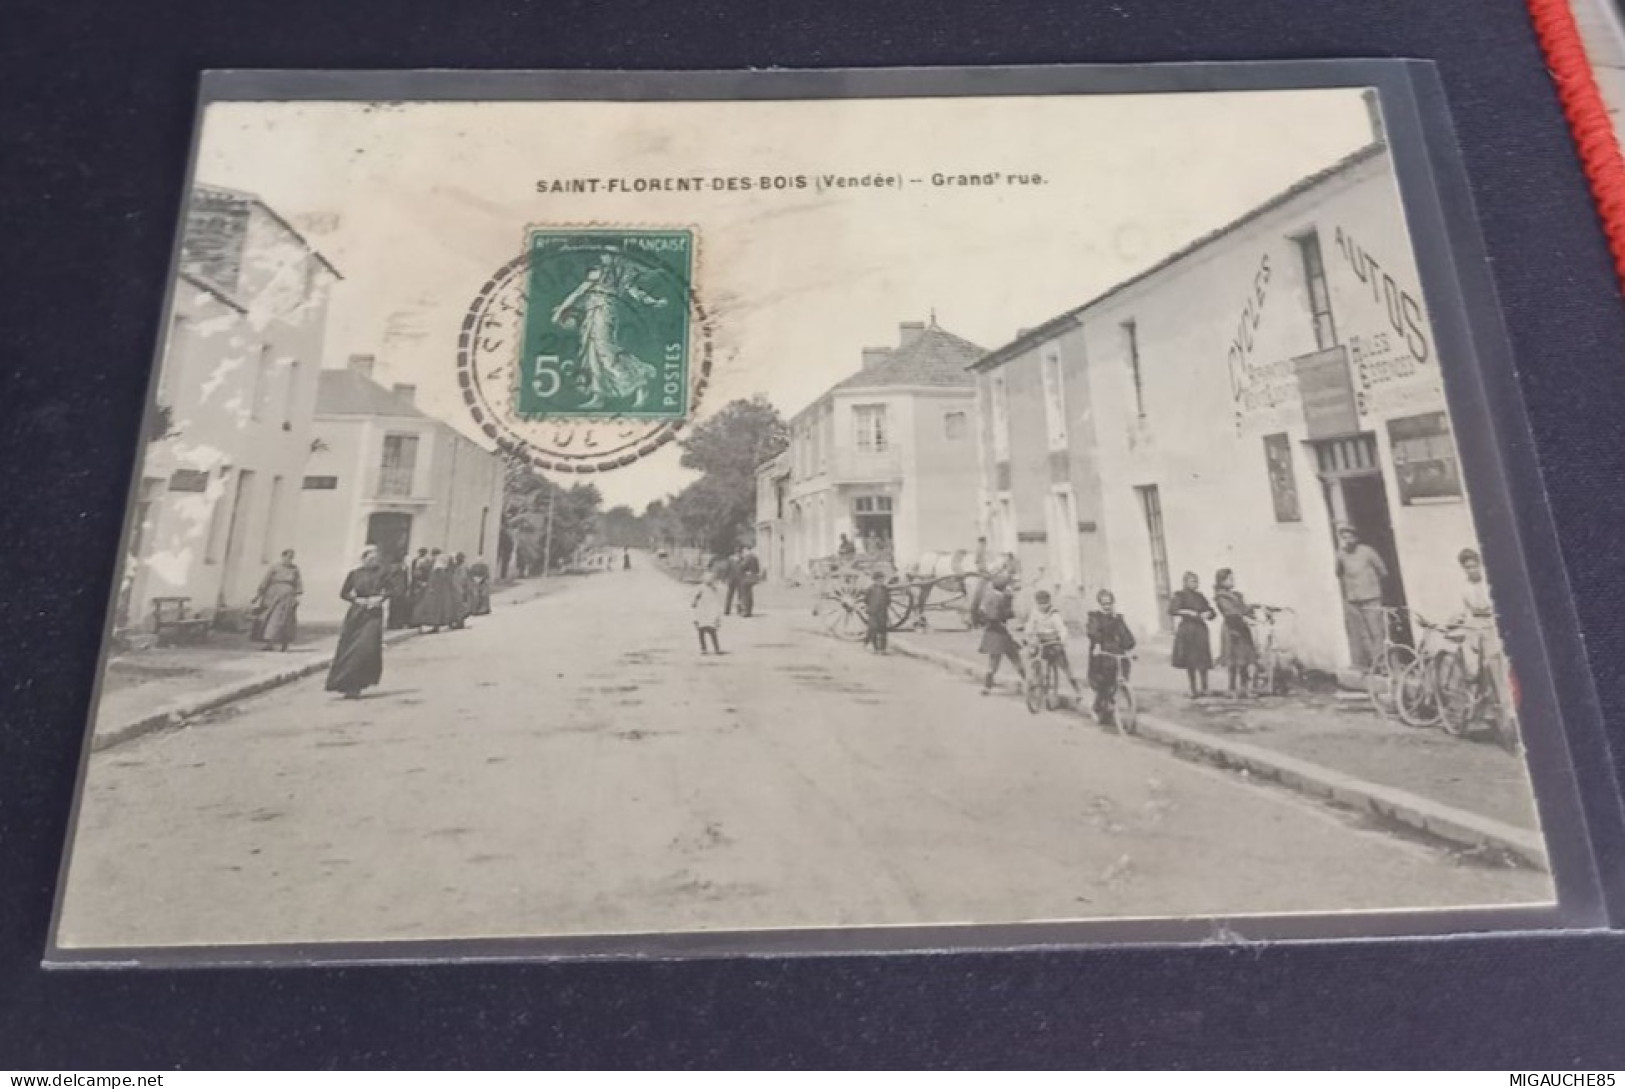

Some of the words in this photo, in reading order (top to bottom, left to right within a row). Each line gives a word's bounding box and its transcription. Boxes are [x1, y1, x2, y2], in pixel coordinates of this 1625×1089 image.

[535, 175, 808, 193] SAINT-FLORENT-DES-BOIS
[815, 173, 904, 195] (Vendée)
[1006, 174, 1050, 187] rue.
[1227, 253, 1271, 403] CYCLES
[1335, 225, 1429, 364] AUTOS
[662, 342, 682, 406] POSTES
